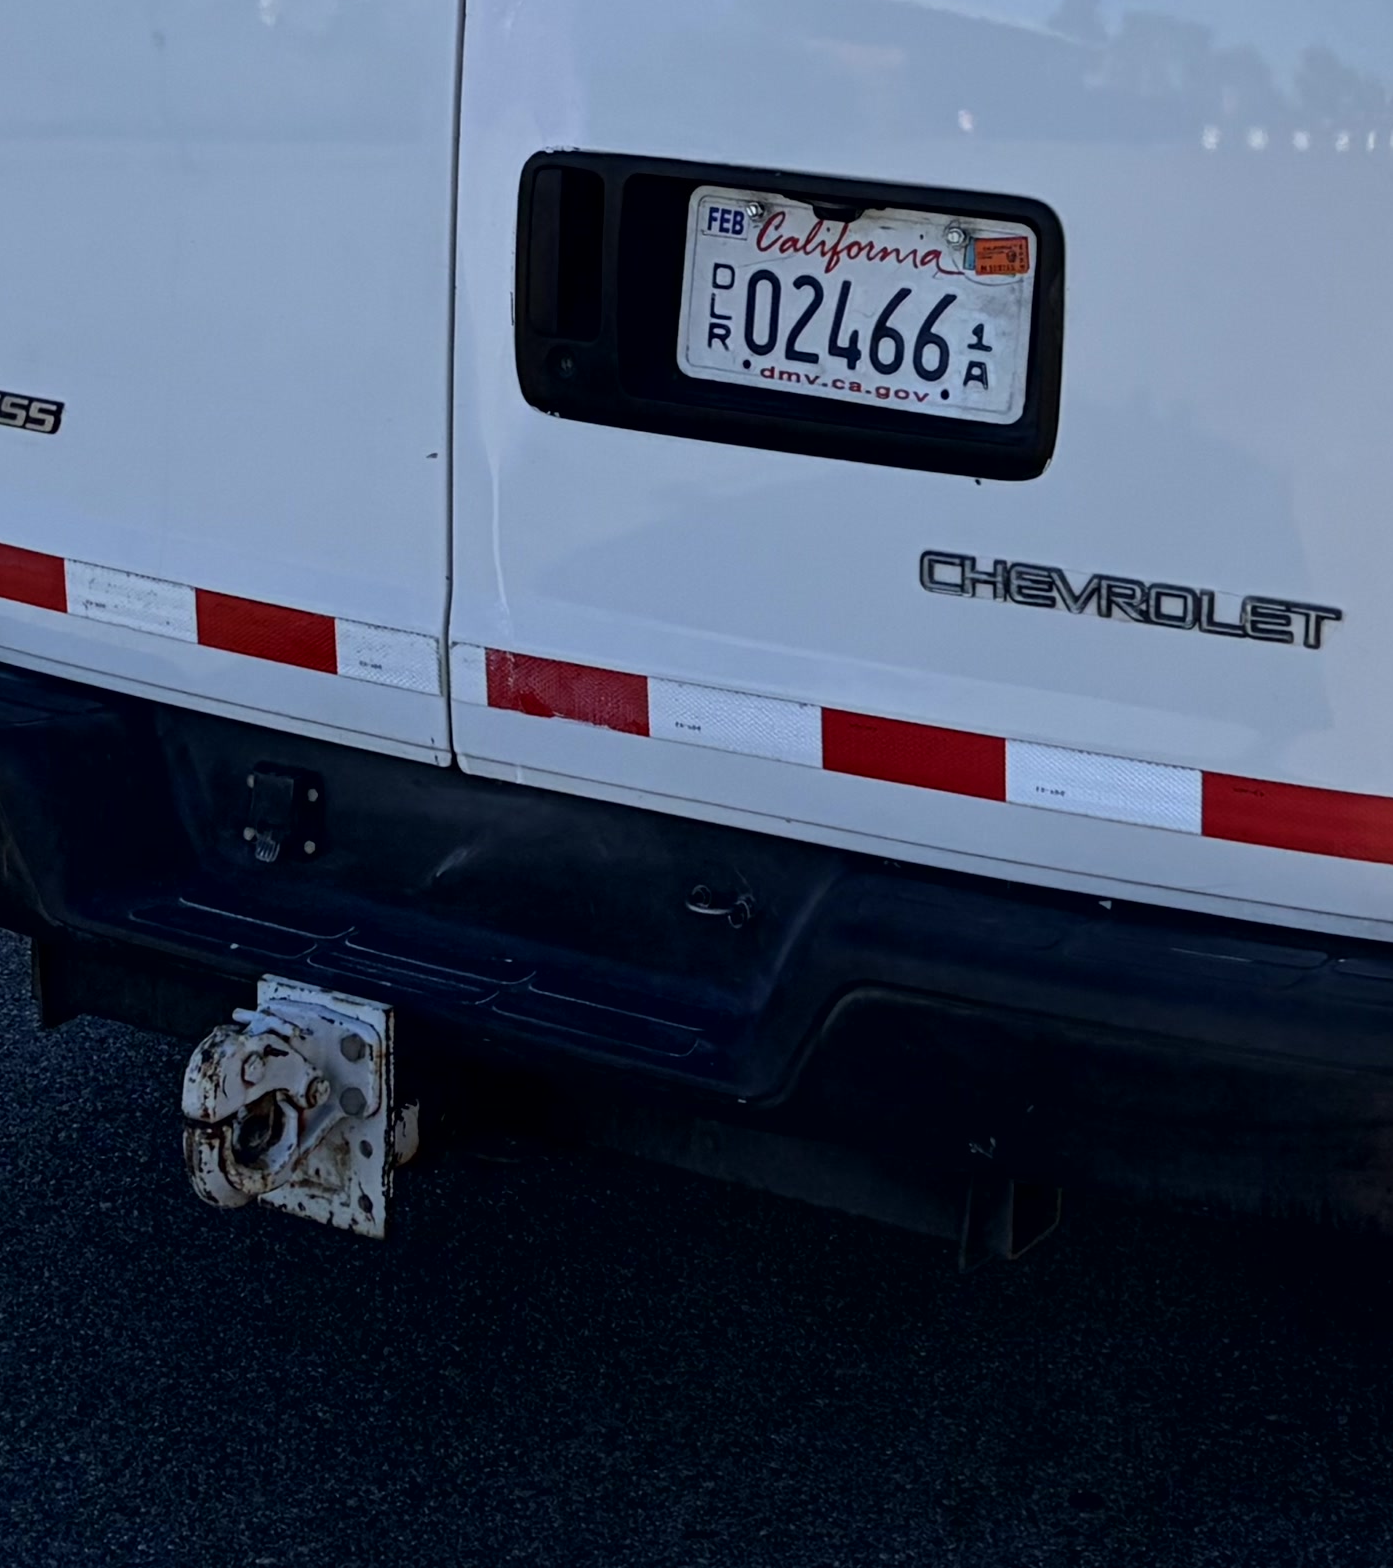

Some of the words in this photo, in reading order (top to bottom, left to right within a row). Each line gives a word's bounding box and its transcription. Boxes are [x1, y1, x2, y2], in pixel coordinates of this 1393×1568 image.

[707, 207, 746, 235] FEB
[756, 211, 964, 275] California
[744, 269, 958, 382] 02466
[760, 366, 930, 403] dmv.ca.gov
[919, 549, 1343, 650] CHEVROLET
